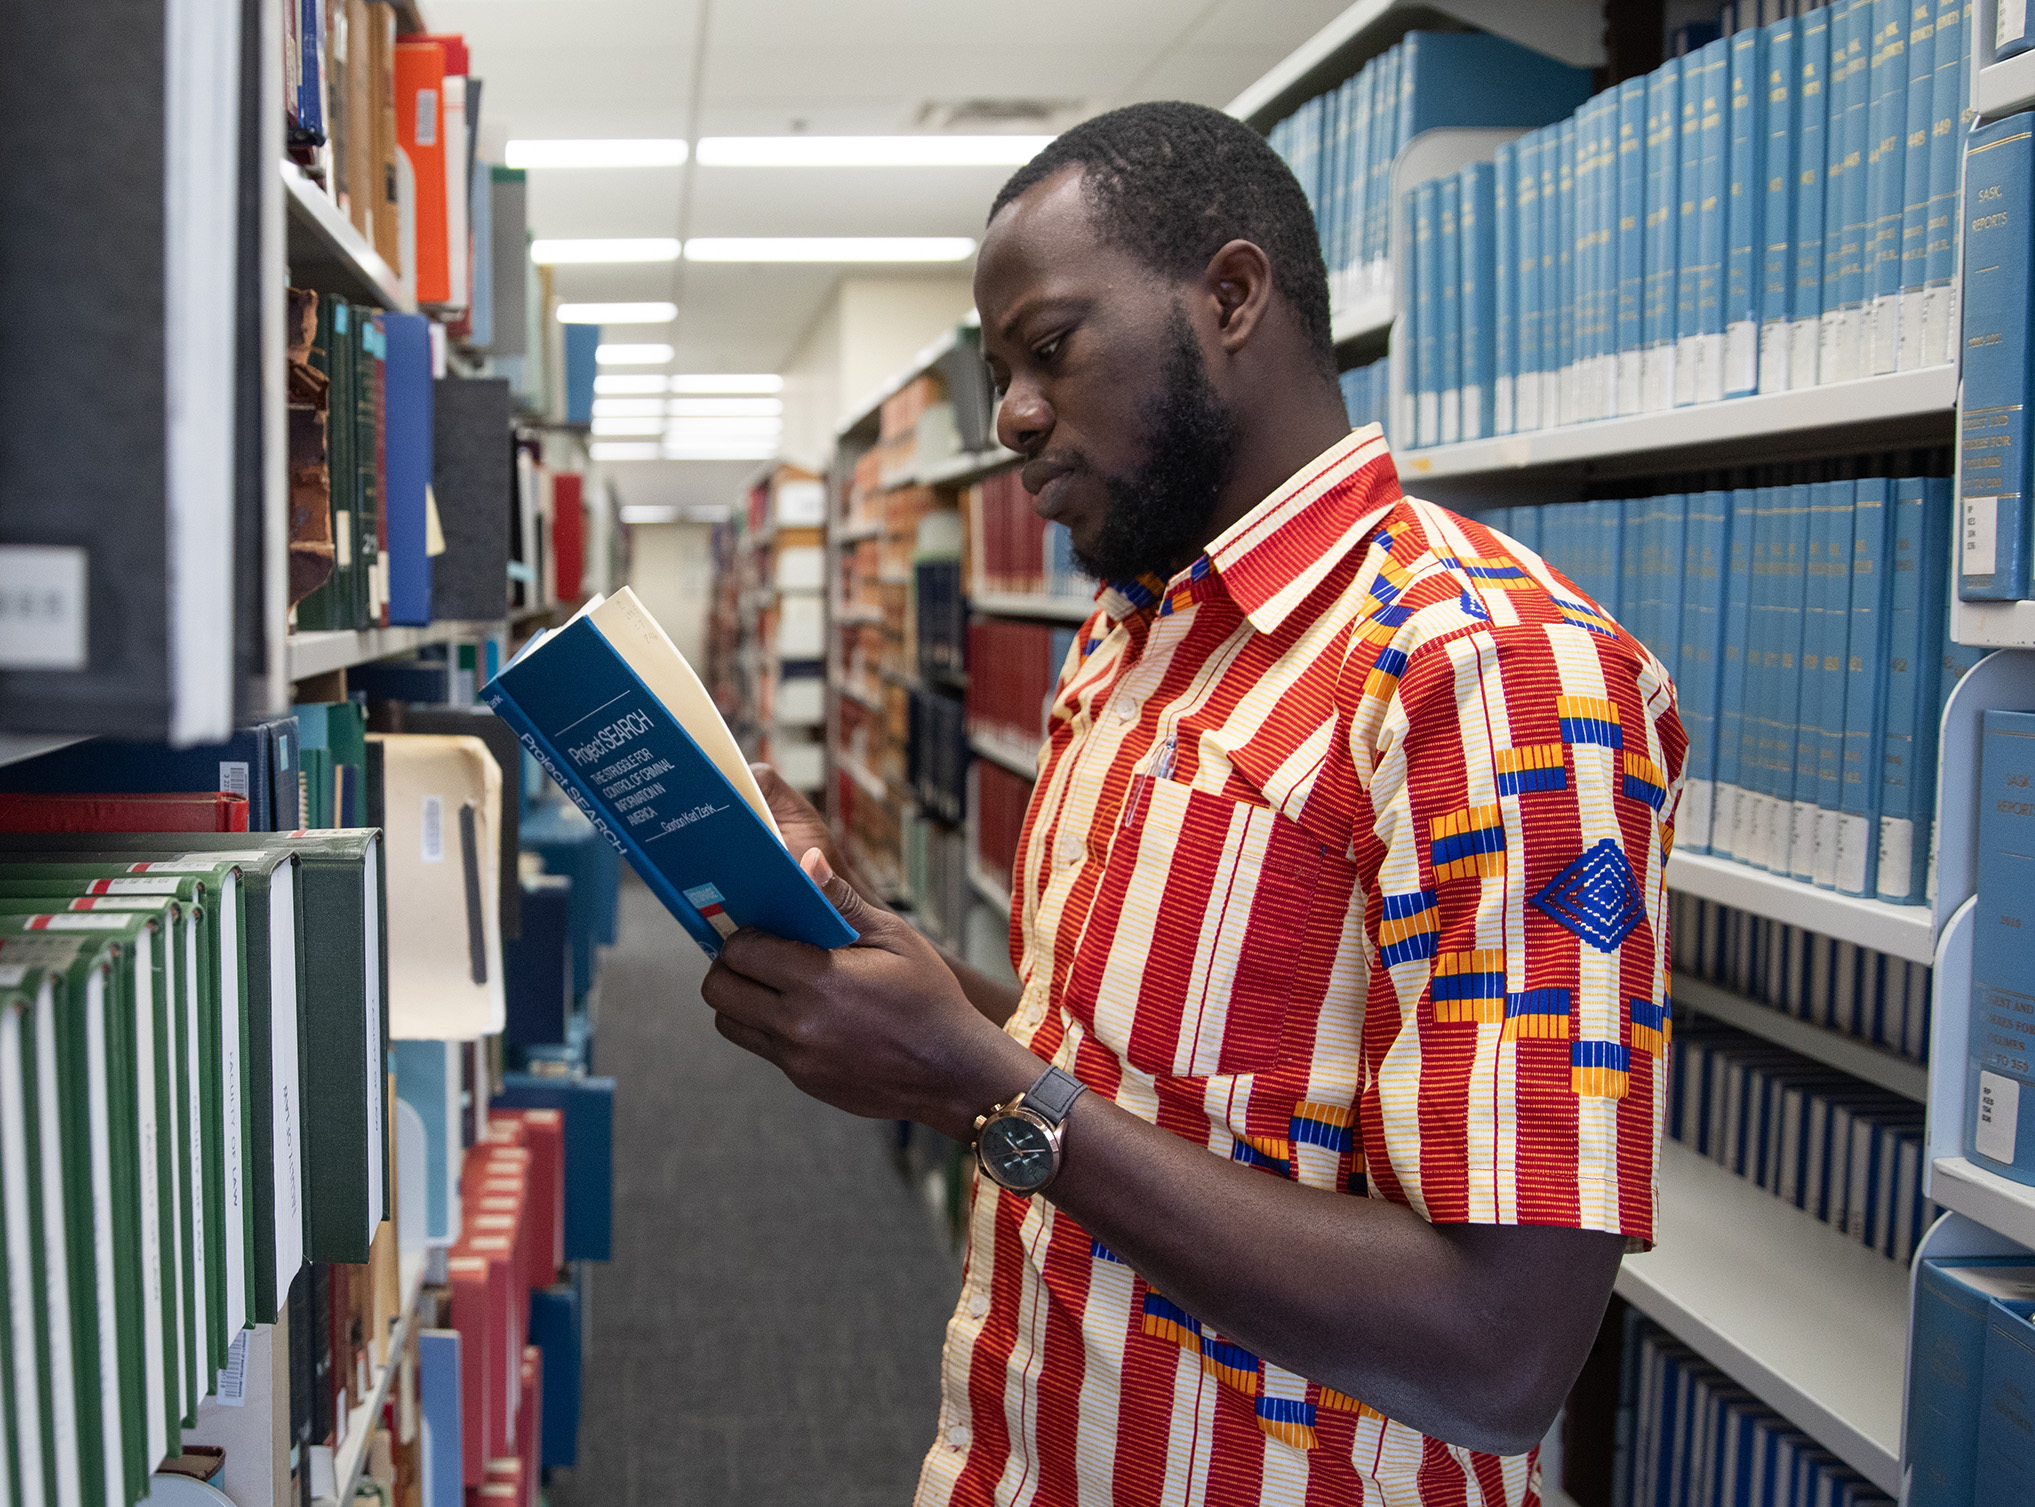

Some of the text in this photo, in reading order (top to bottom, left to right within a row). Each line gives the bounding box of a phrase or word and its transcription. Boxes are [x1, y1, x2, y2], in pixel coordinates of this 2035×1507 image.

[568, 709, 655, 766] Project SEARCH
[590, 748, 653, 785] THE STRUGGLE FOR
[602, 759, 675, 799] CONTROL OF CRIMINAL
[614, 782, 667, 813] INFORMATION IN
[567, 786, 628, 855] SEARCH
[626, 806, 658, 826] AMERICA
[661, 803, 718, 833] Gordon Karl Zenk
[2014, 1001, 2035, 1015] AND
[2015, 1021, 2035, 1036] FOR
